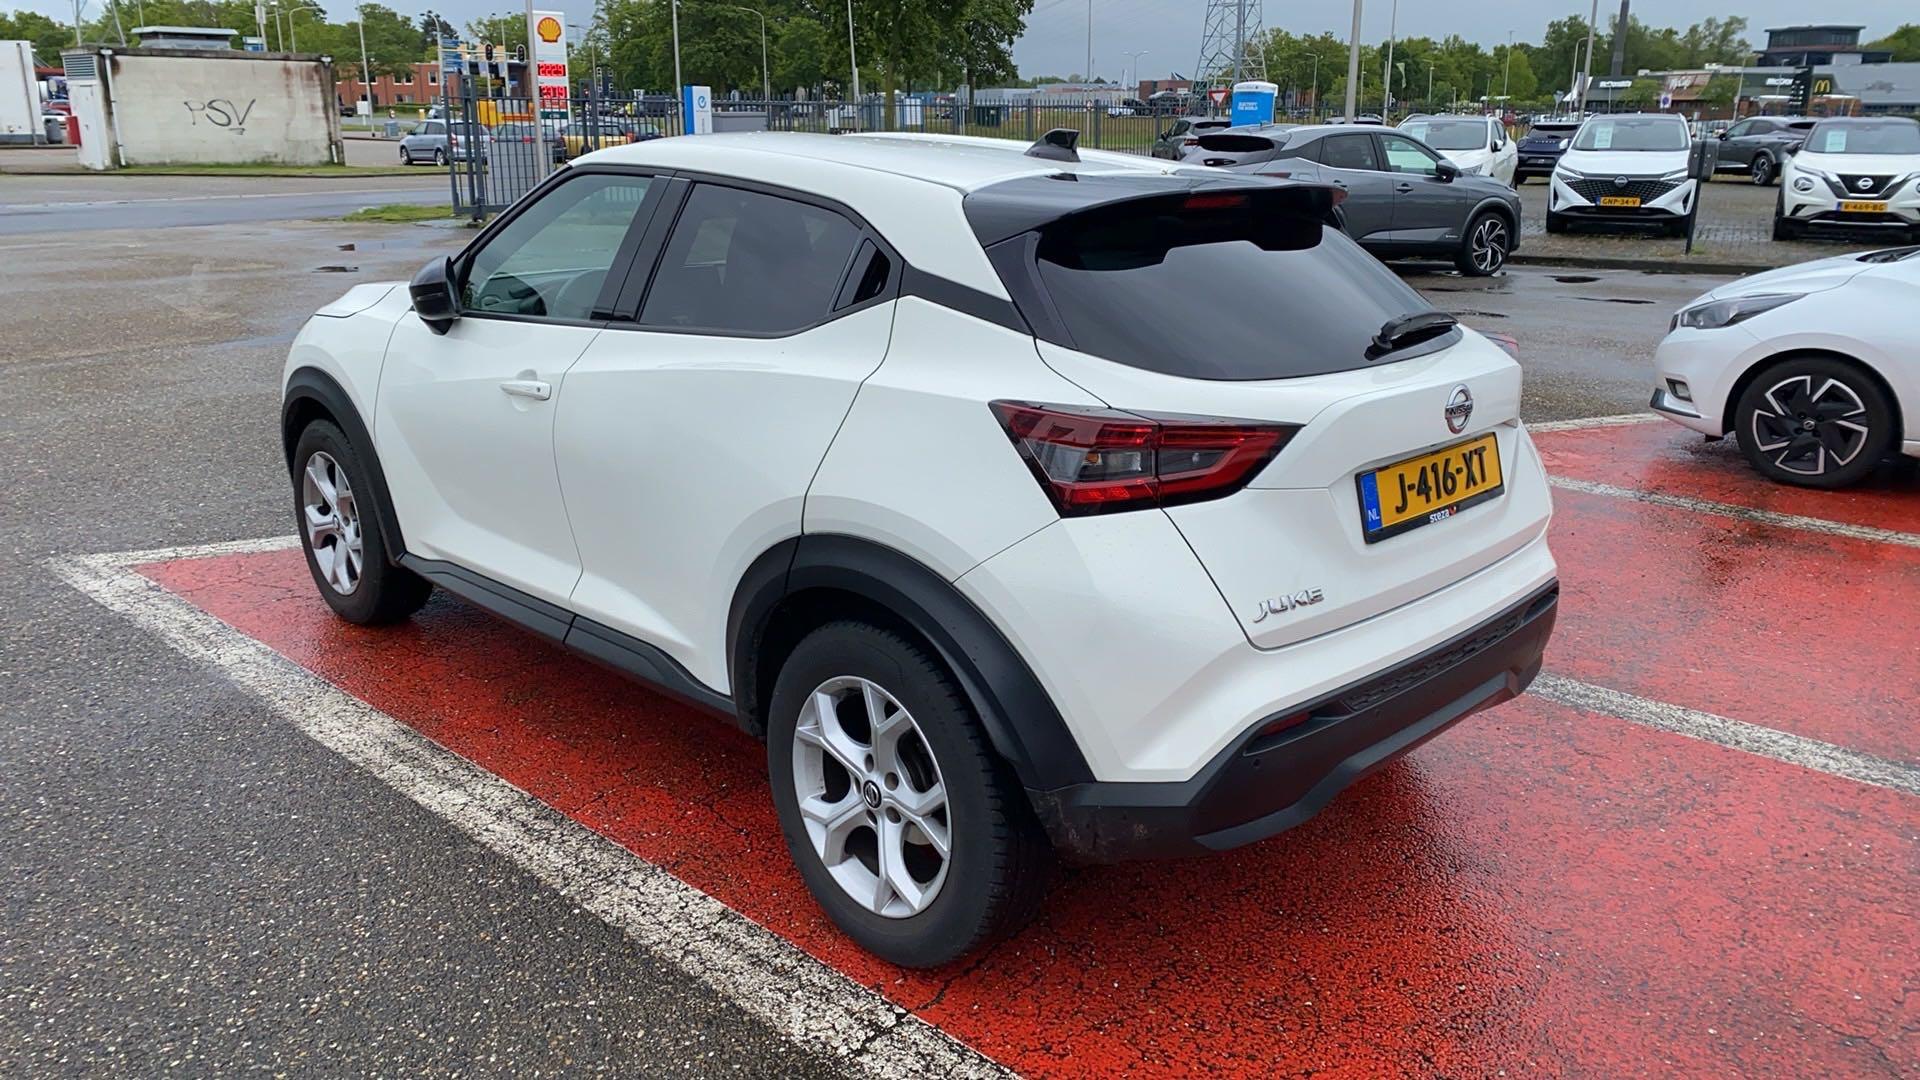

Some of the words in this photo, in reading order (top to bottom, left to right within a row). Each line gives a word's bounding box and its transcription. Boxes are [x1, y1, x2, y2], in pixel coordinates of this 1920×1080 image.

[184, 98, 256, 126] PSV
[1395, 445, 1487, 514] J-416-XT
[1367, 509, 1381, 522] NL
[1253, 587, 1325, 623] JUKE
